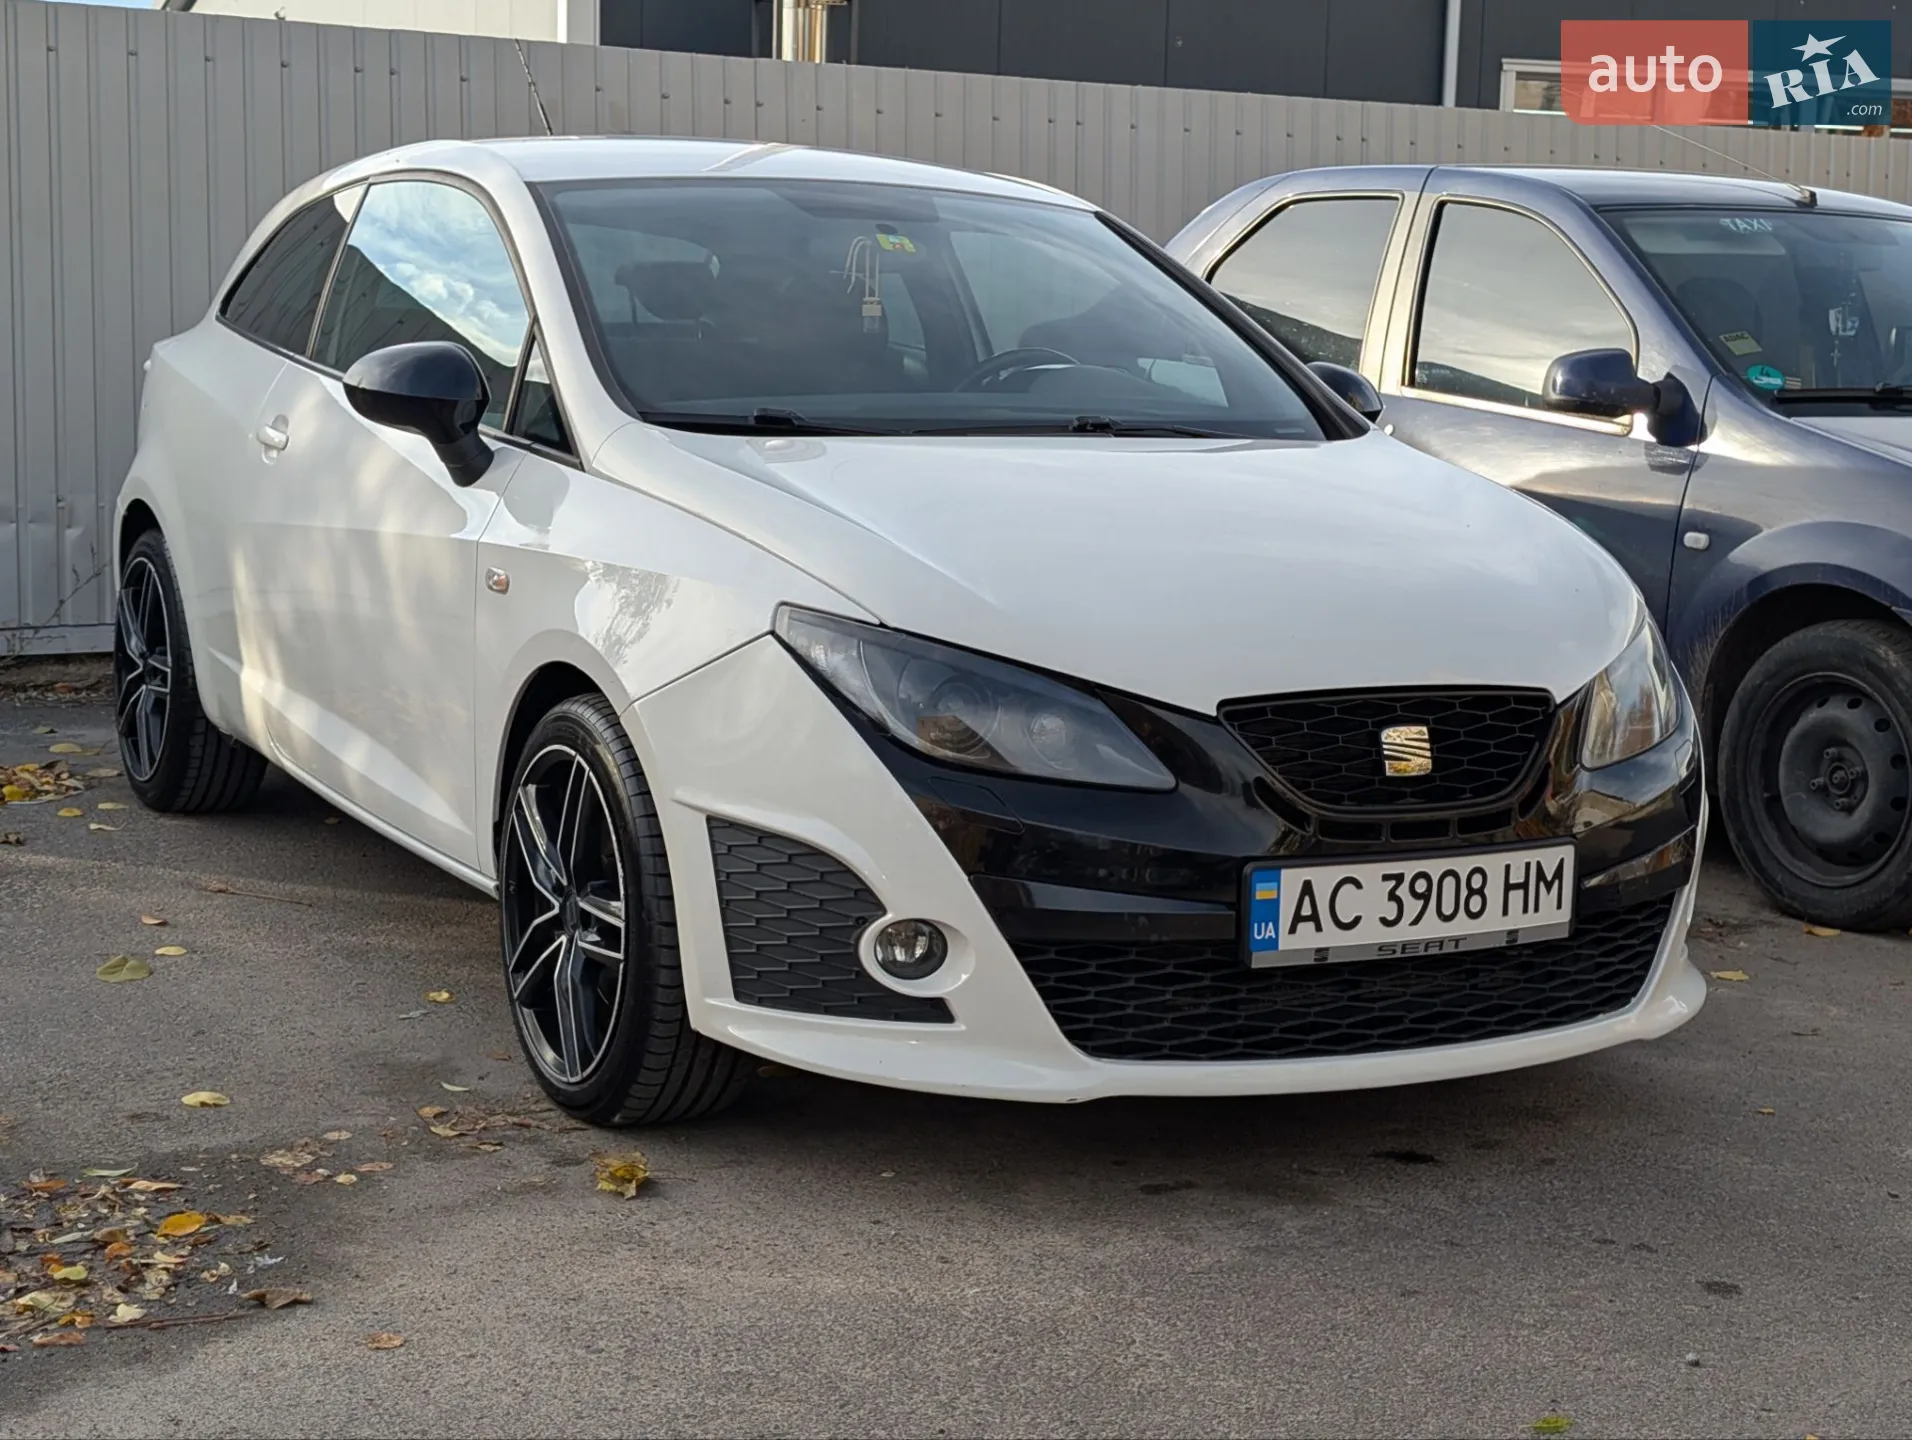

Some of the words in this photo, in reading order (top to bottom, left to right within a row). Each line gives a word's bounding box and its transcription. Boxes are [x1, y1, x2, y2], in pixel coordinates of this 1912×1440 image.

[1720, 217, 1773, 234] TAXI
[1287, 876, 1364, 936] AC
[1378, 866, 1488, 928] 3908
[1502, 856, 1566, 917] HM
[1253, 922, 1277, 940] UA
[1376, 937, 1468, 957] SEAT
